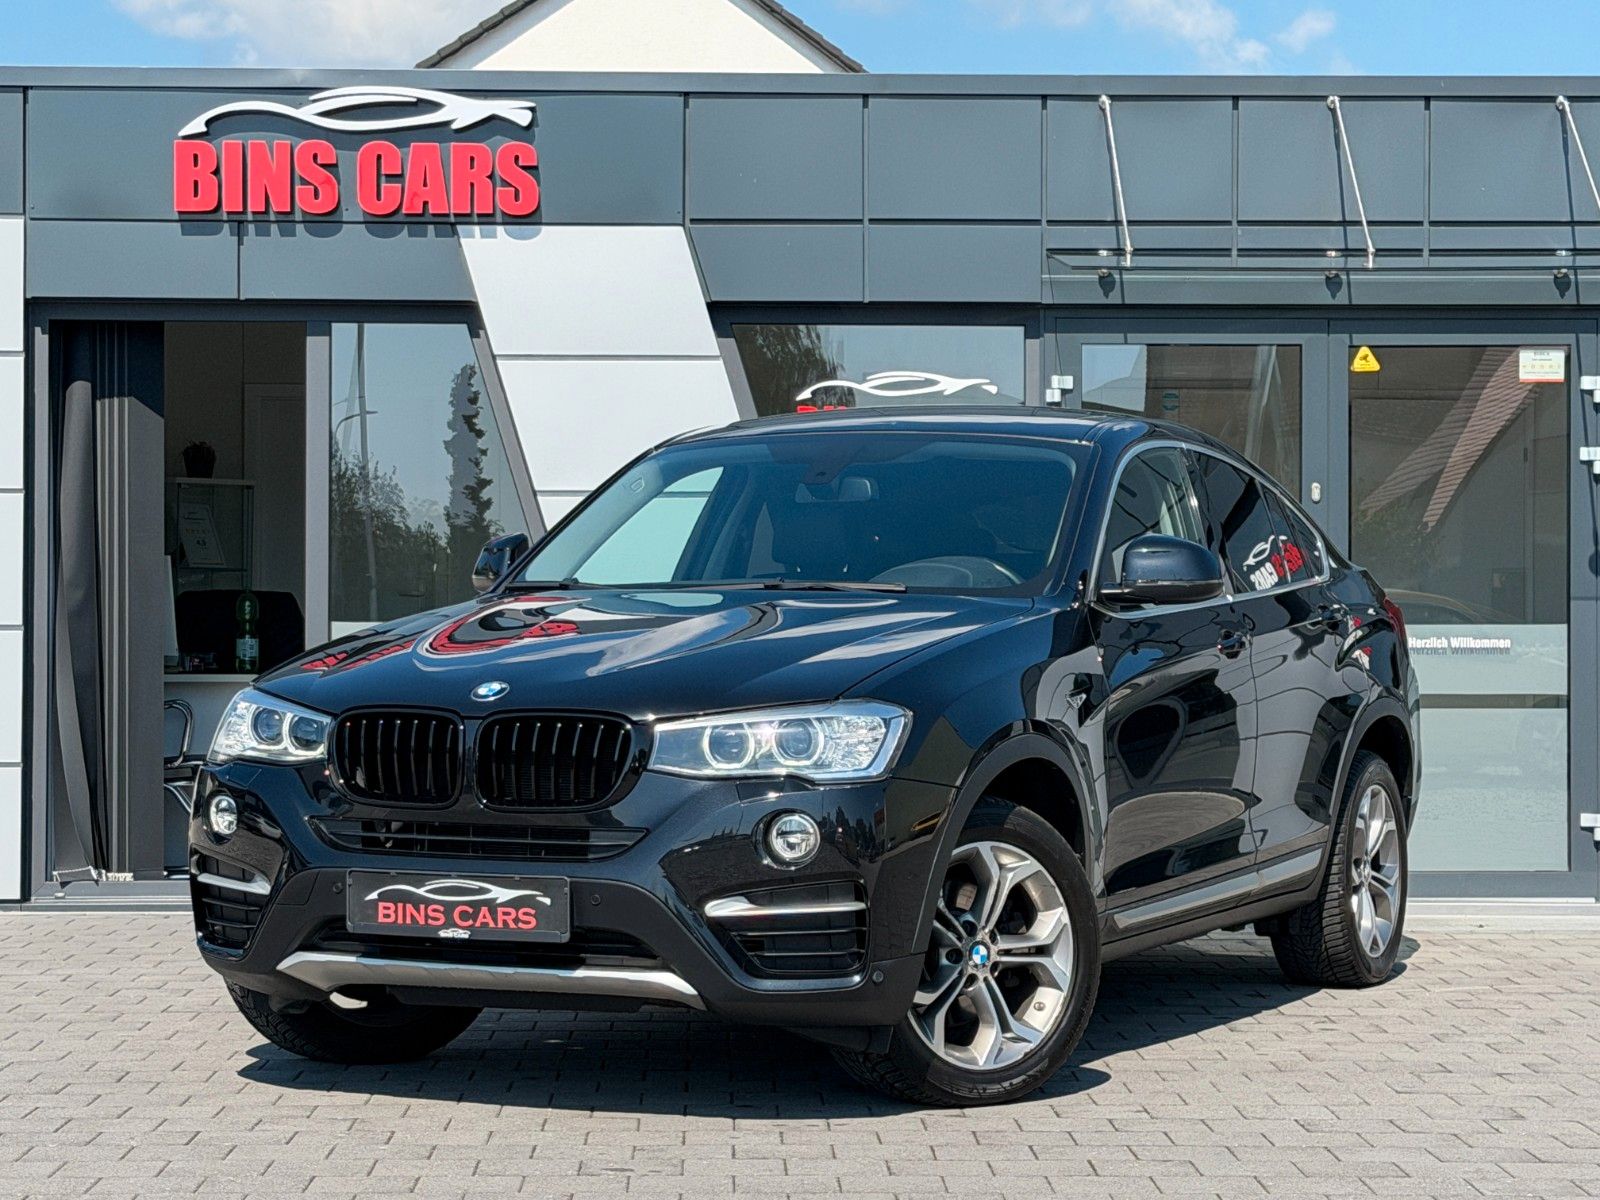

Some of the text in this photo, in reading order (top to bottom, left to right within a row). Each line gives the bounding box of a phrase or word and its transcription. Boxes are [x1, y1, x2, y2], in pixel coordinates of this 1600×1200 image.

[173, 139, 540, 215] BINS CARS
[1408, 637, 1511, 648] Herzlich Willkommen
[377, 901, 538, 929] BINS CARS
